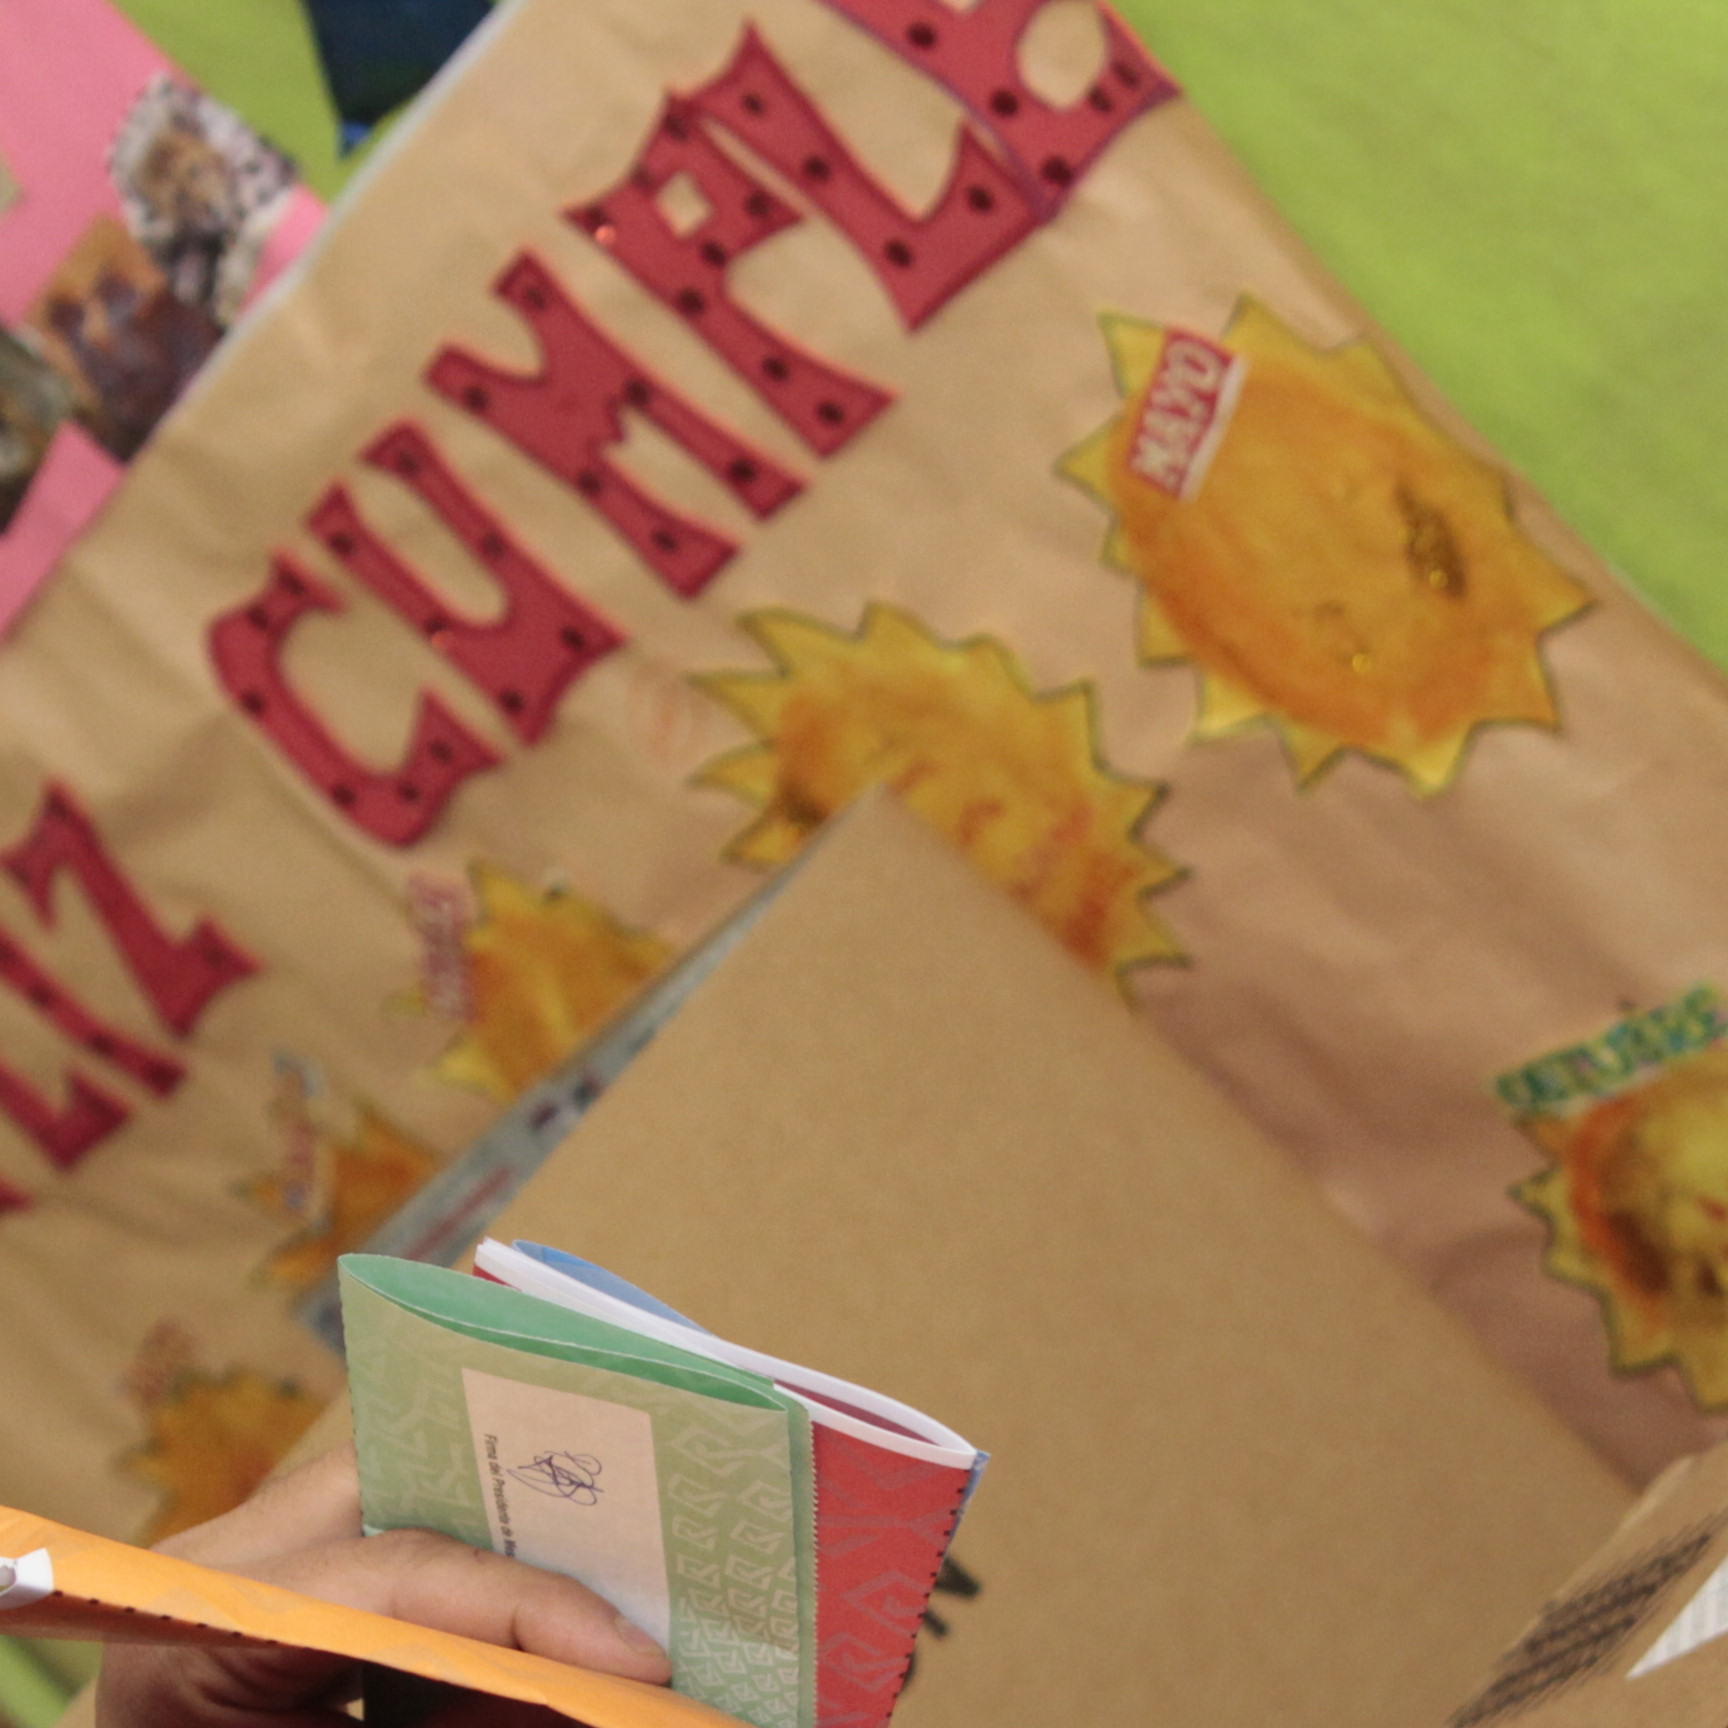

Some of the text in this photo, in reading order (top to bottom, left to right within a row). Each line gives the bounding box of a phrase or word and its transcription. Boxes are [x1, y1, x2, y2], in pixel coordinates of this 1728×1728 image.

[1128, 337, 1226, 492] MAYO
[483, 1433, 518, 1559] Firma del Presidente de Mes
